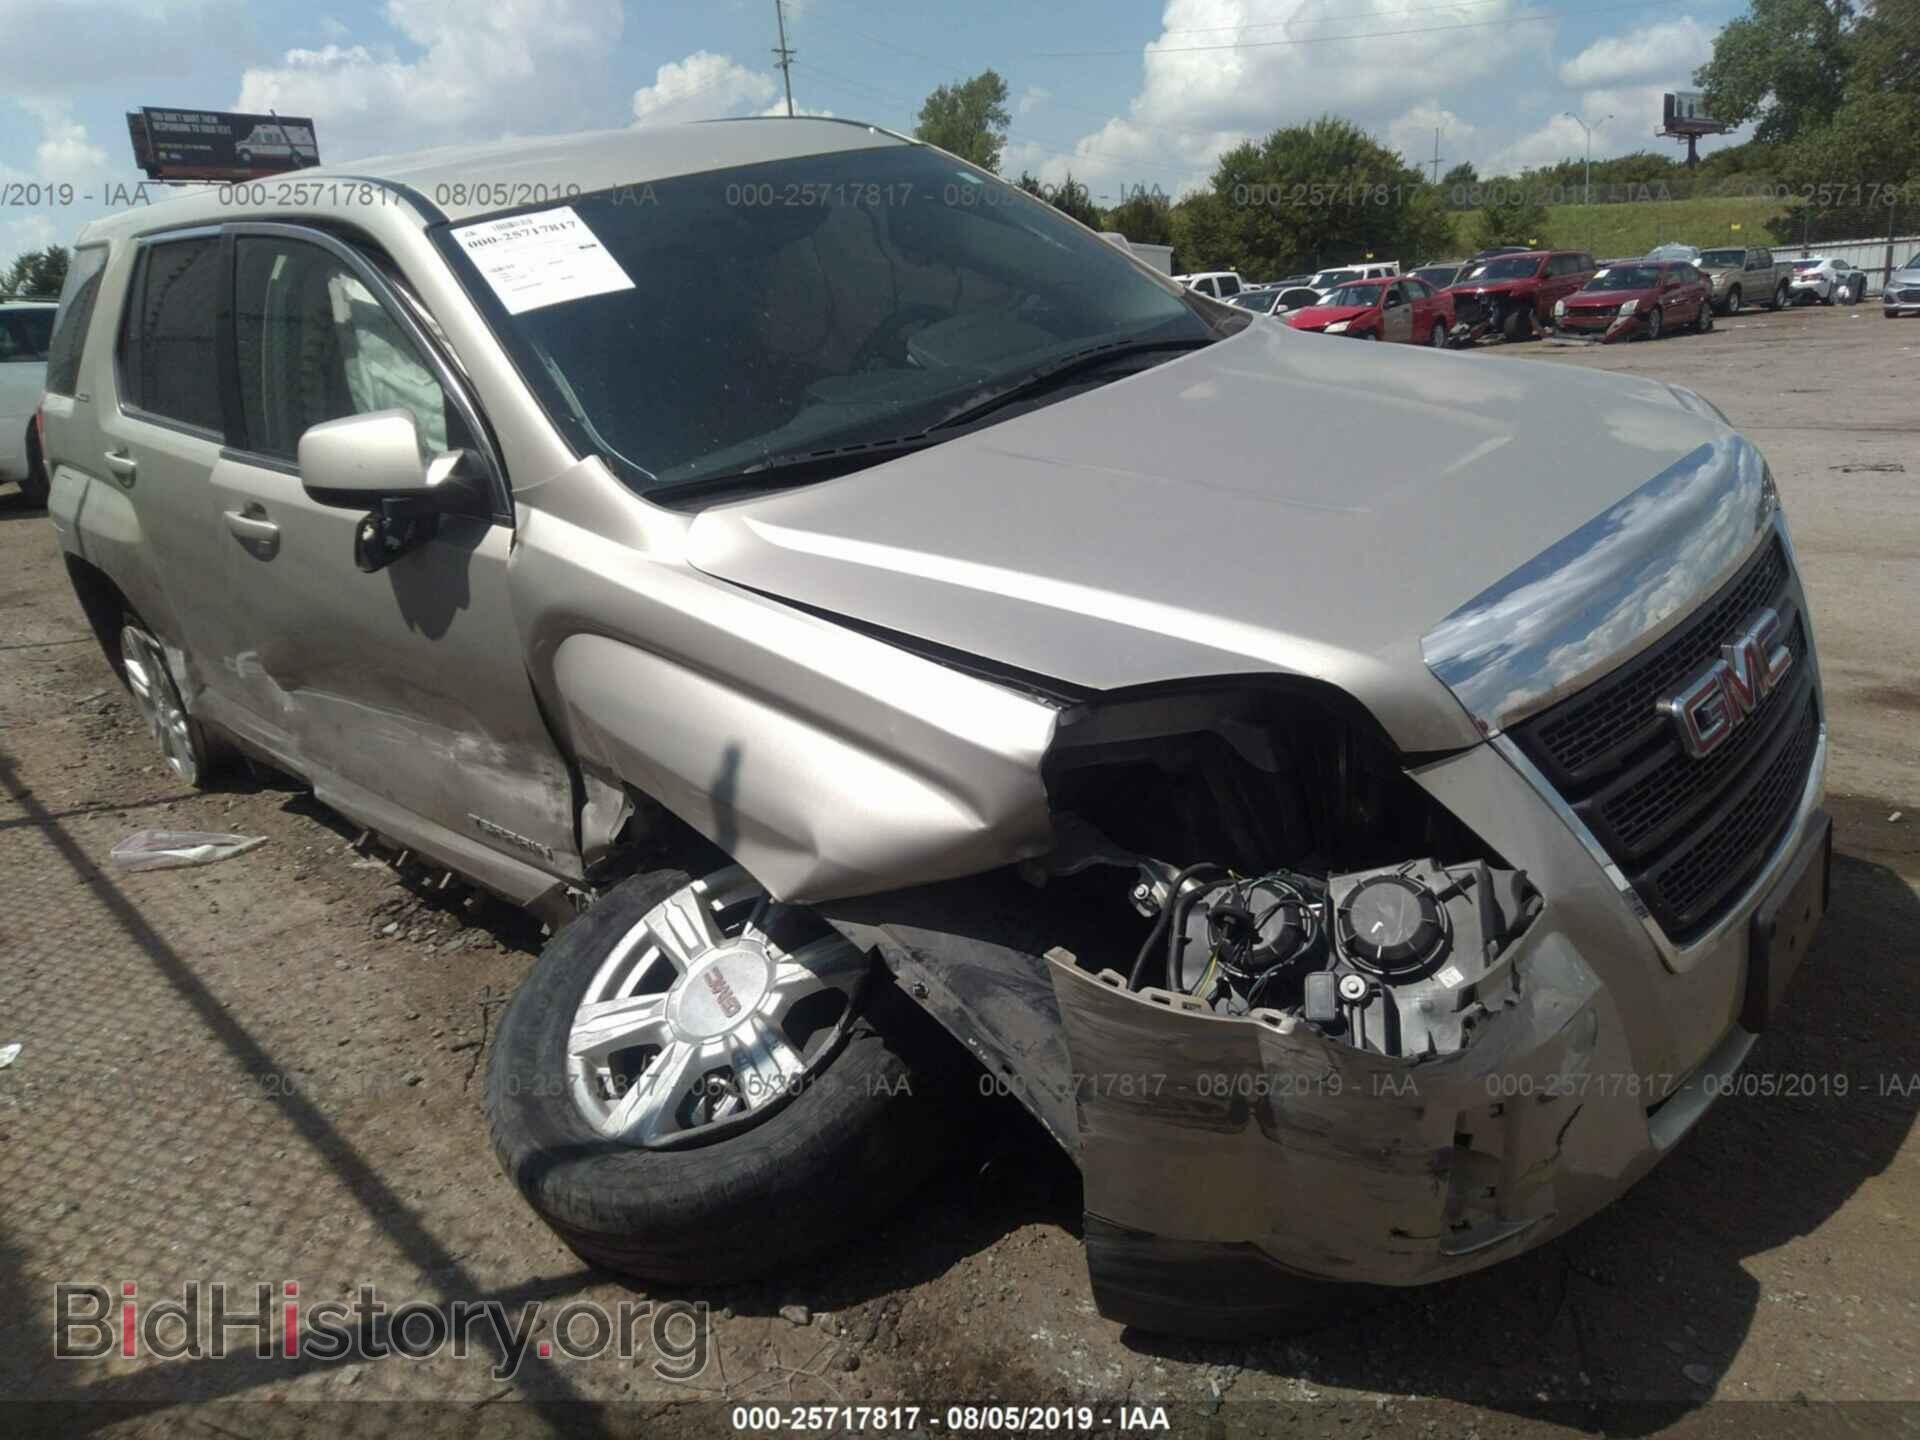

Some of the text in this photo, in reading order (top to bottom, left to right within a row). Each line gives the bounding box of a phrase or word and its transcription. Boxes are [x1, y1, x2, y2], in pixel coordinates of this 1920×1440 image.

[467, 220, 577, 250] 000-25717817
[1668, 606, 1793, 760] GMC
[703, 966, 742, 1019] GMC
